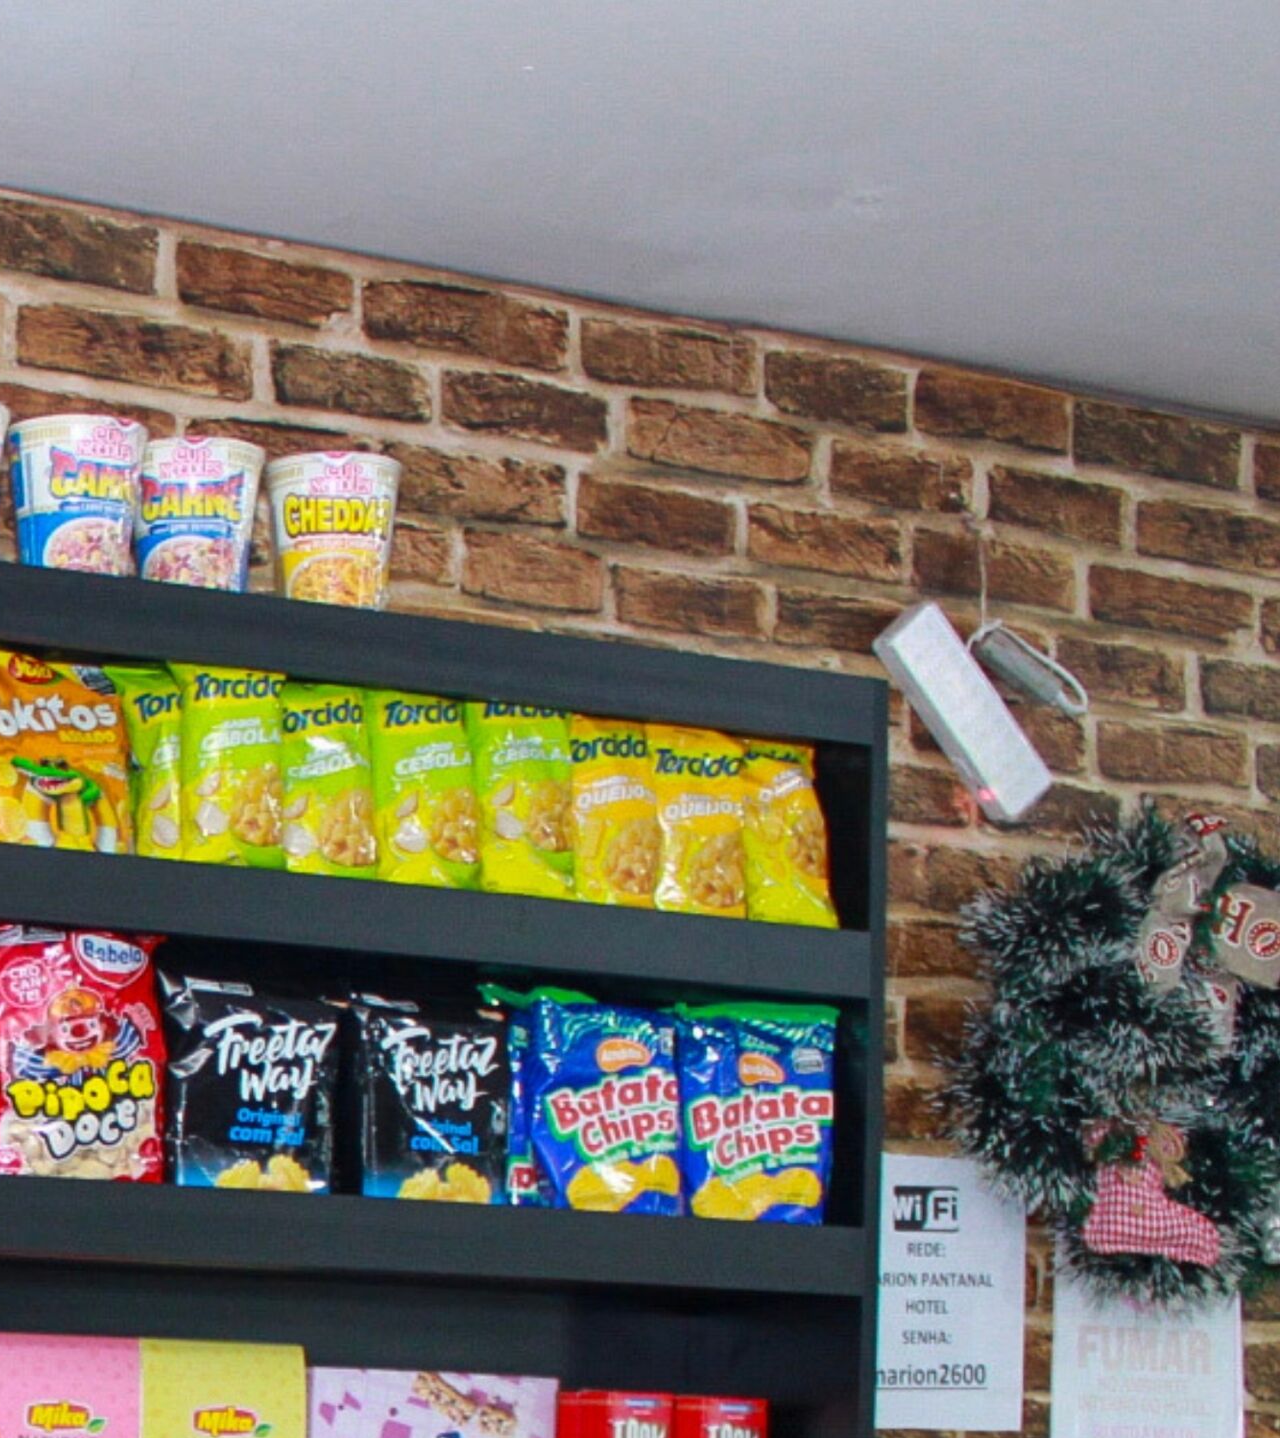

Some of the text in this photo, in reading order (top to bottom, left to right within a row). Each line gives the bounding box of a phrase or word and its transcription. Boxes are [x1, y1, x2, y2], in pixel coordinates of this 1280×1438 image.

[139, 470, 245, 524] CARNE
[12, 653, 55, 681] Yoki
[691, 1091, 832, 1142] Batata
[229, 1124, 305, 1146] com Sal
[580, 1107, 675, 1155] Chips
[715, 1123, 819, 1168] Chips
[906, 1242, 946, 1258] REDE:
[921, 1272, 994, 1289] PANTANAL
[905, 1300, 949, 1316] HOTEL
[901, 1331, 953, 1346] SENHA:
[1077, 1326, 1212, 1373] FUMAR
